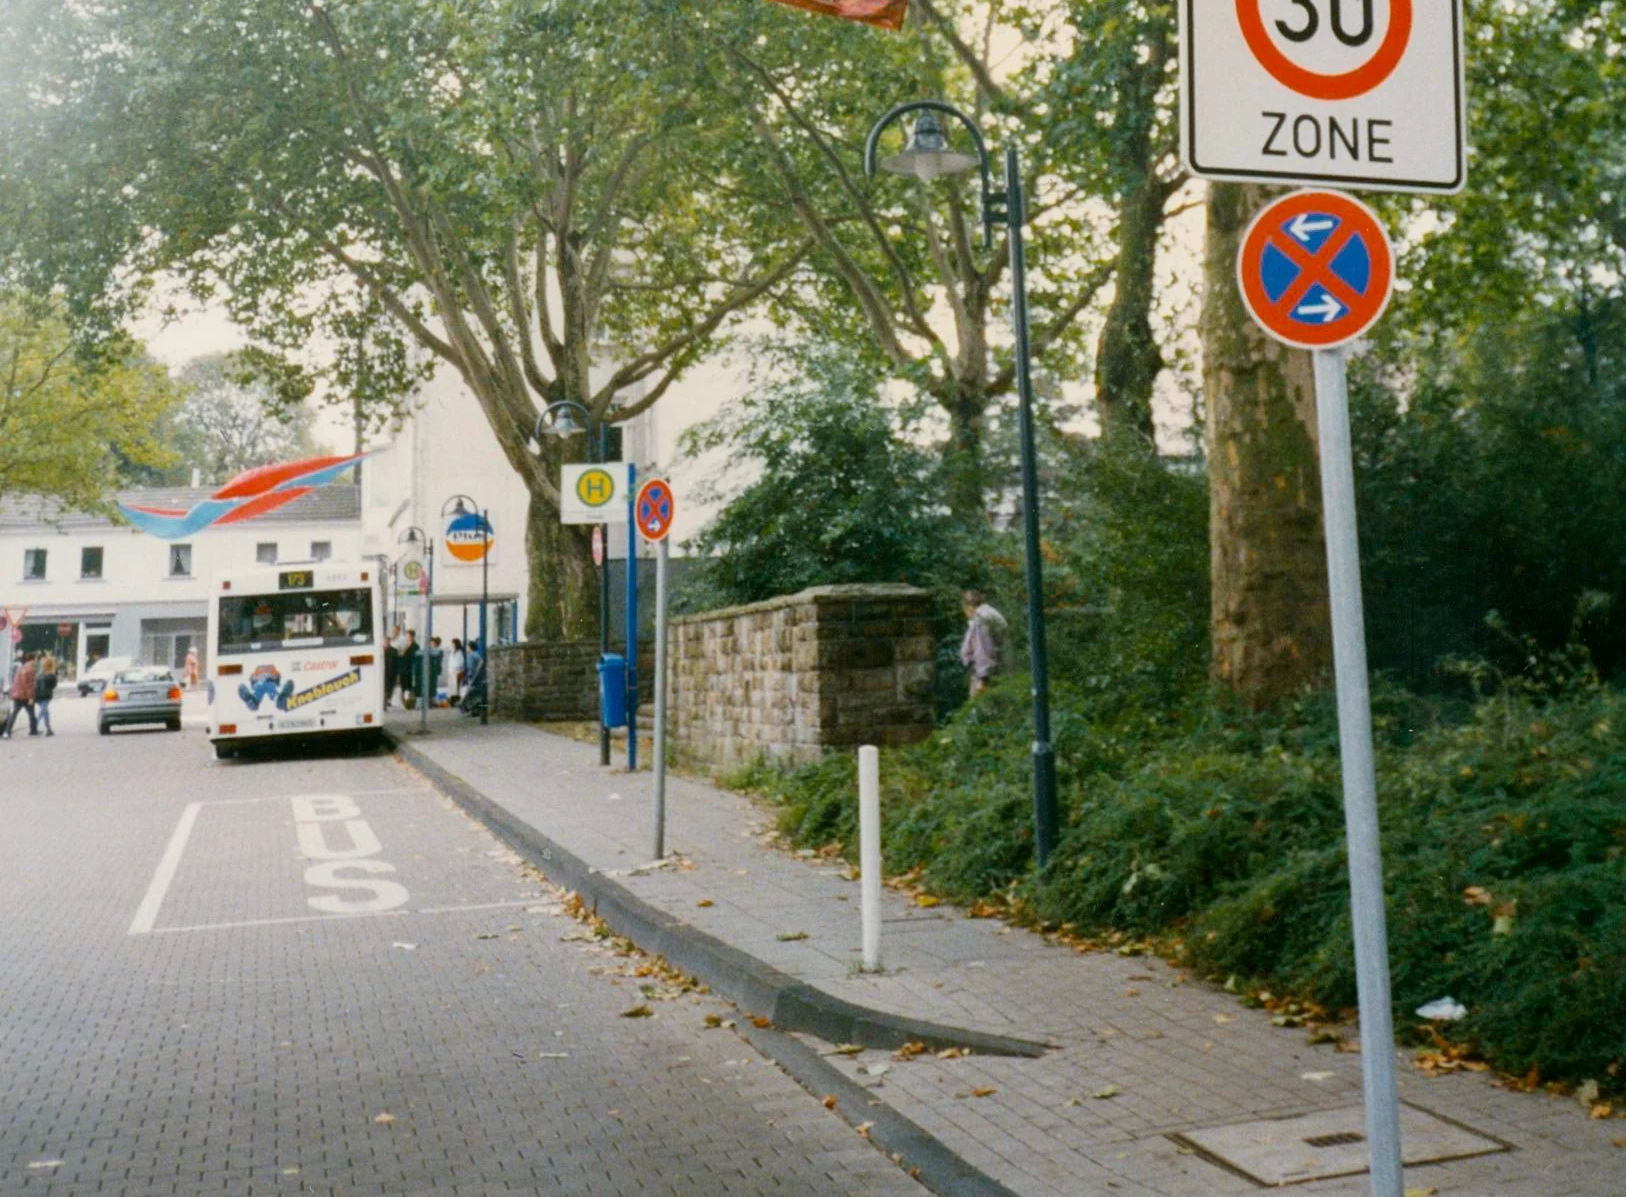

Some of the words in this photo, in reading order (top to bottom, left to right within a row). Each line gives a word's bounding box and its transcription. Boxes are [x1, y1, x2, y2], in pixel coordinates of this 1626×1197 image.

[1261, 111, 1393, 163] ZONE
[586, 477, 605, 500] H
[291, 794, 411, 914] BUS
